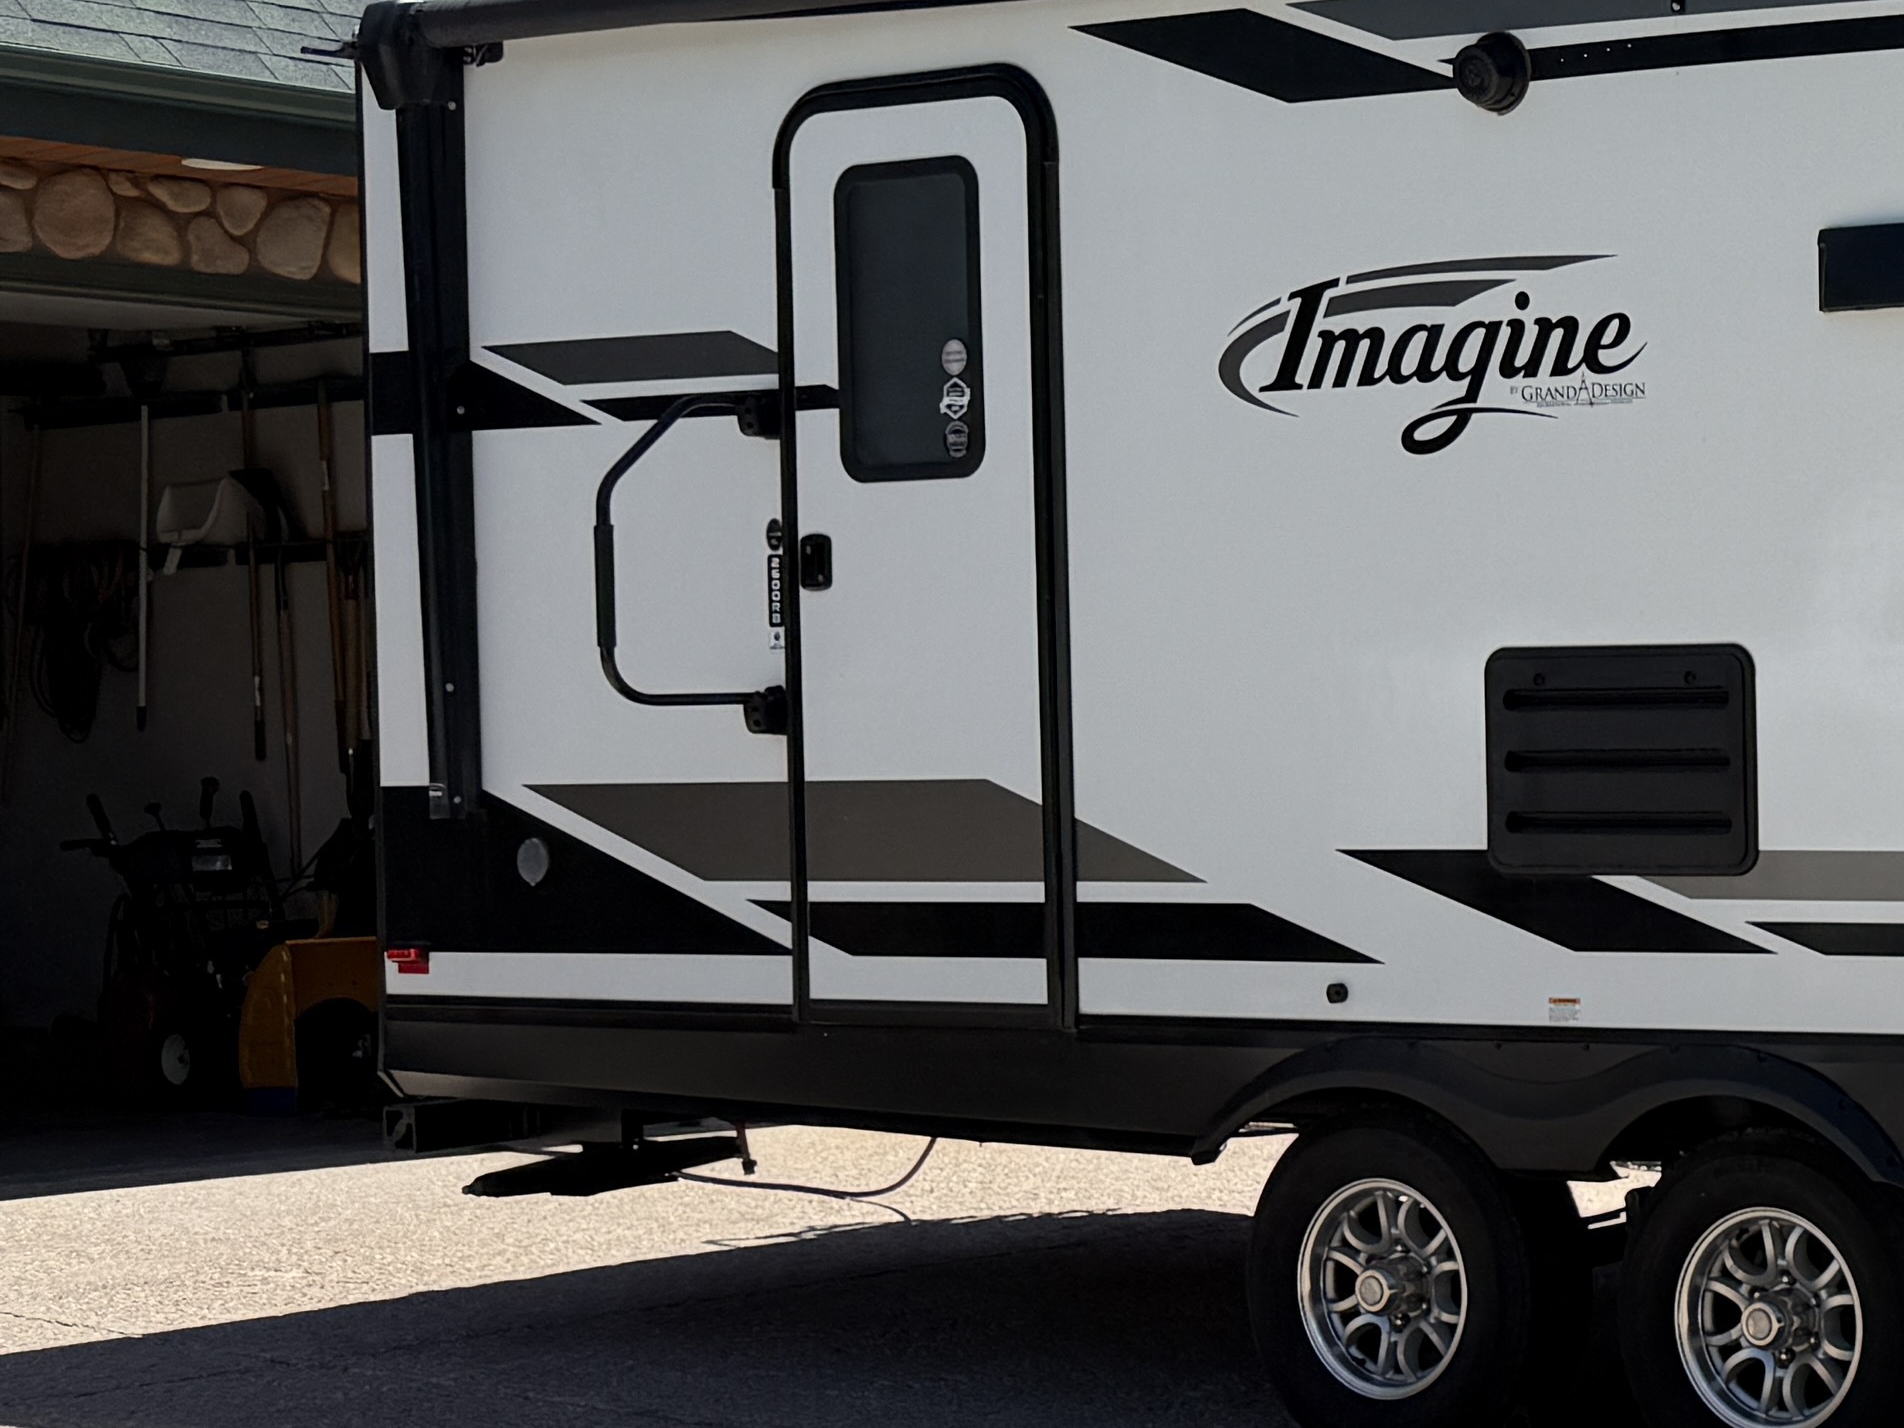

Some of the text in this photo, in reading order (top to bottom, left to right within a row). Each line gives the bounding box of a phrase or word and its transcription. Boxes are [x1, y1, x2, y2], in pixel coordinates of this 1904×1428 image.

[1258, 276, 1648, 456] Imagine
[1521, 384, 1577, 403] GRAND
[1591, 376, 1647, 399] DESIGN
